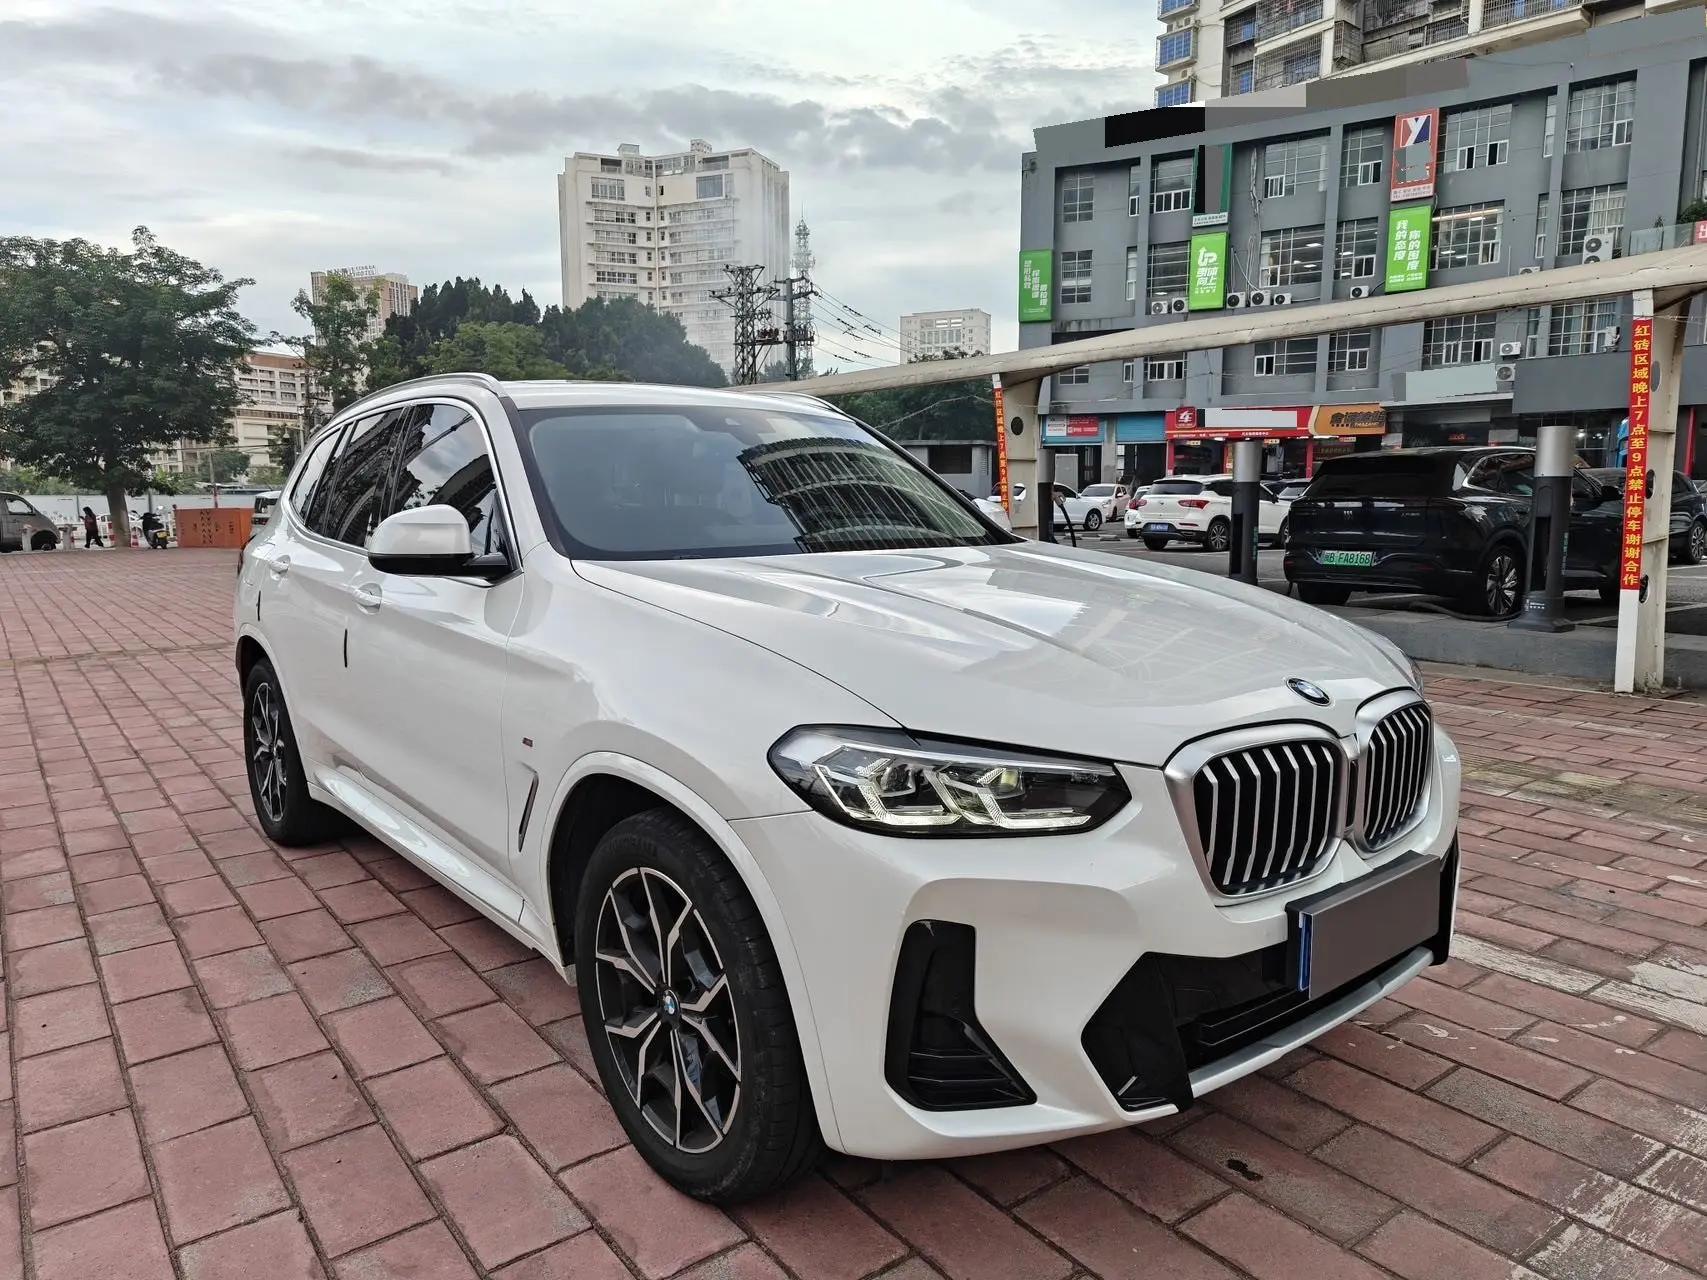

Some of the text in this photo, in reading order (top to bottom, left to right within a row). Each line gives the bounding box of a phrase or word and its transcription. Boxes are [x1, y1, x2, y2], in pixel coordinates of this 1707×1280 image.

[1394, 219, 1408, 261] 我的态度
[1407, 230, 1421, 271] 你的围度
[1623, 323, 1651, 586] 红砖区域晚上7点至9点禁止停车谢谢合作
